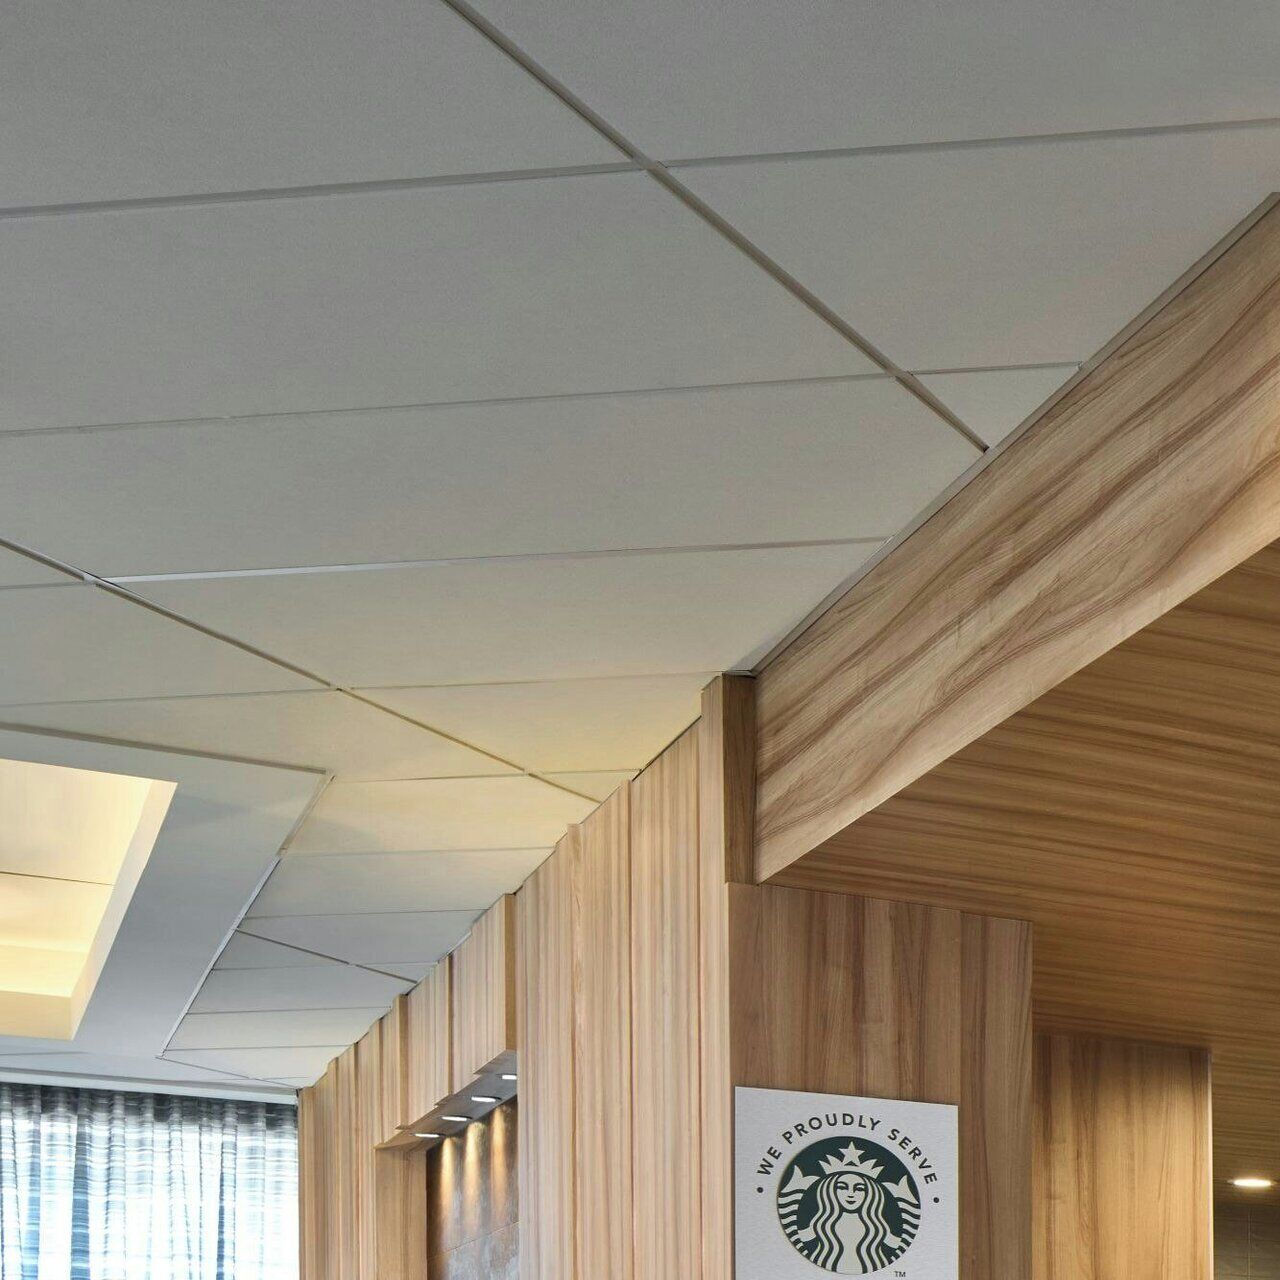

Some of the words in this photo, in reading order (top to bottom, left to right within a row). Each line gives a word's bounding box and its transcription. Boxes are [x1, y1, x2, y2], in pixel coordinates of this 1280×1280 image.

[757, 1146, 783, 1177] WE
[781, 1112, 881, 1145] PROUDLY
[887, 1128, 938, 1185] SERVE
